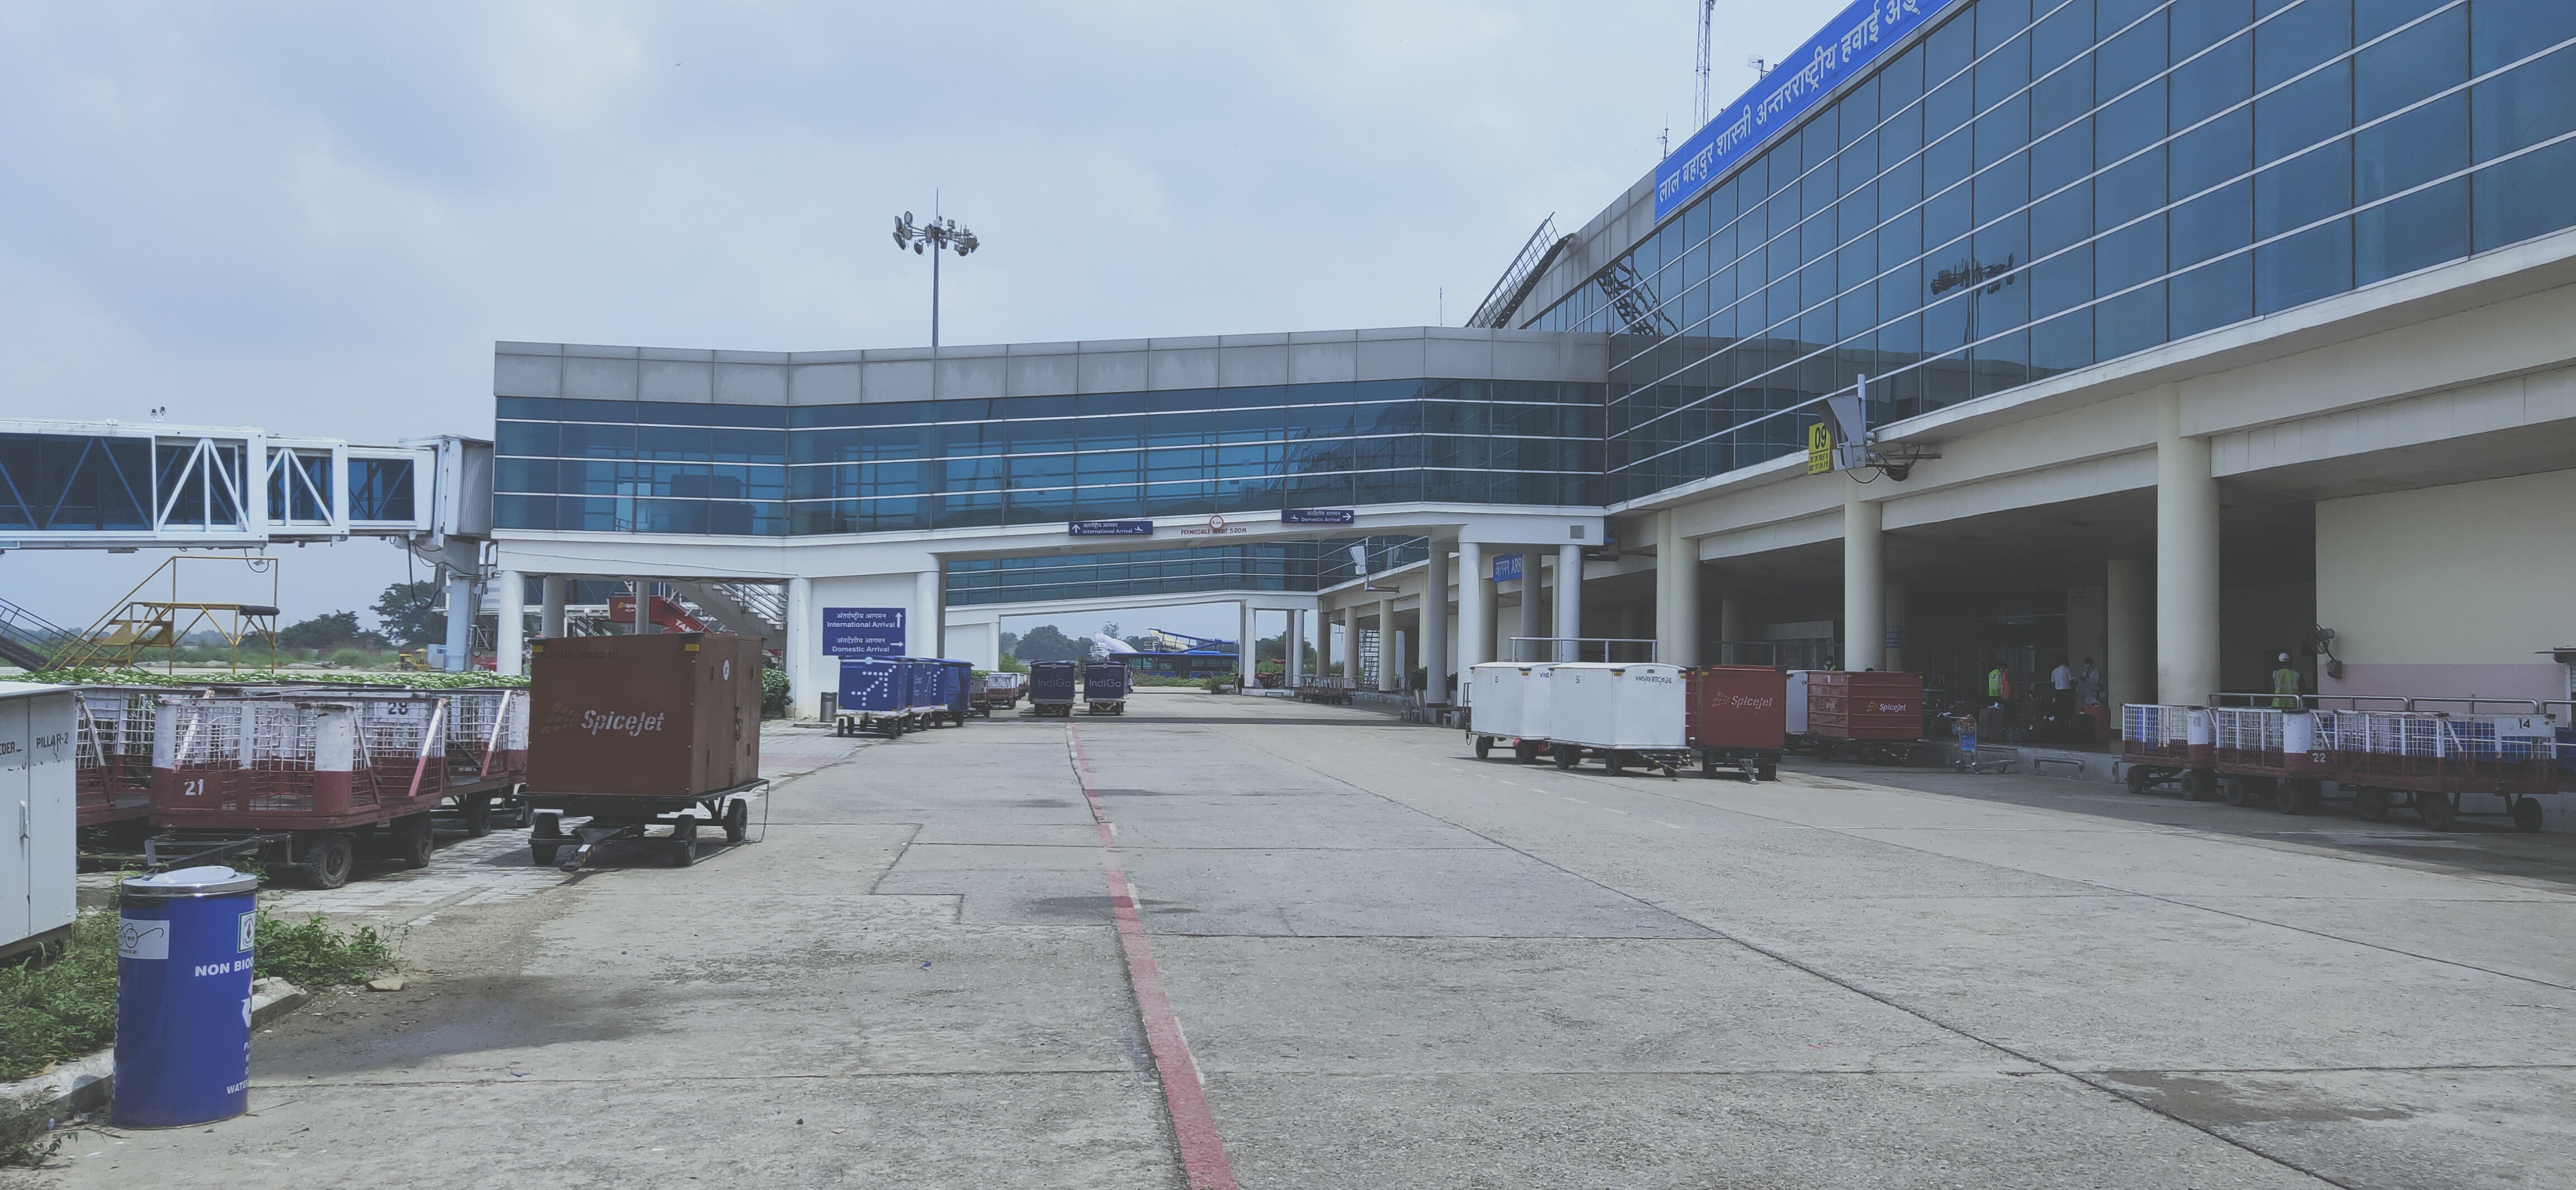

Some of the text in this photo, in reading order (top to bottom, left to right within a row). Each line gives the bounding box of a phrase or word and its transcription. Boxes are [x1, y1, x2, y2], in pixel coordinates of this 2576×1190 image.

[1659, 169, 1679, 202] लाल
[1683, 142, 1713, 180] बहादुर
[1716, 105, 1751, 157] शास्त्री
[1841, 0, 1880, 63] हवाई
[1815, 425, 1827, 450] 09
[1495, 560, 1509, 577] आगमन
[1038, 678, 1071, 687] IndiGo
[1090, 678, 1121, 687] IndiGo
[1575, 675, 1580, 684] 36
[389, 702, 408, 715] 28
[581, 710, 665, 736] SpiceJet
[2517, 718, 2530, 729] 14
[2312, 753, 2326, 763] 22
[184, 778, 204, 796] 21
[195, 962, 230, 977] NON
